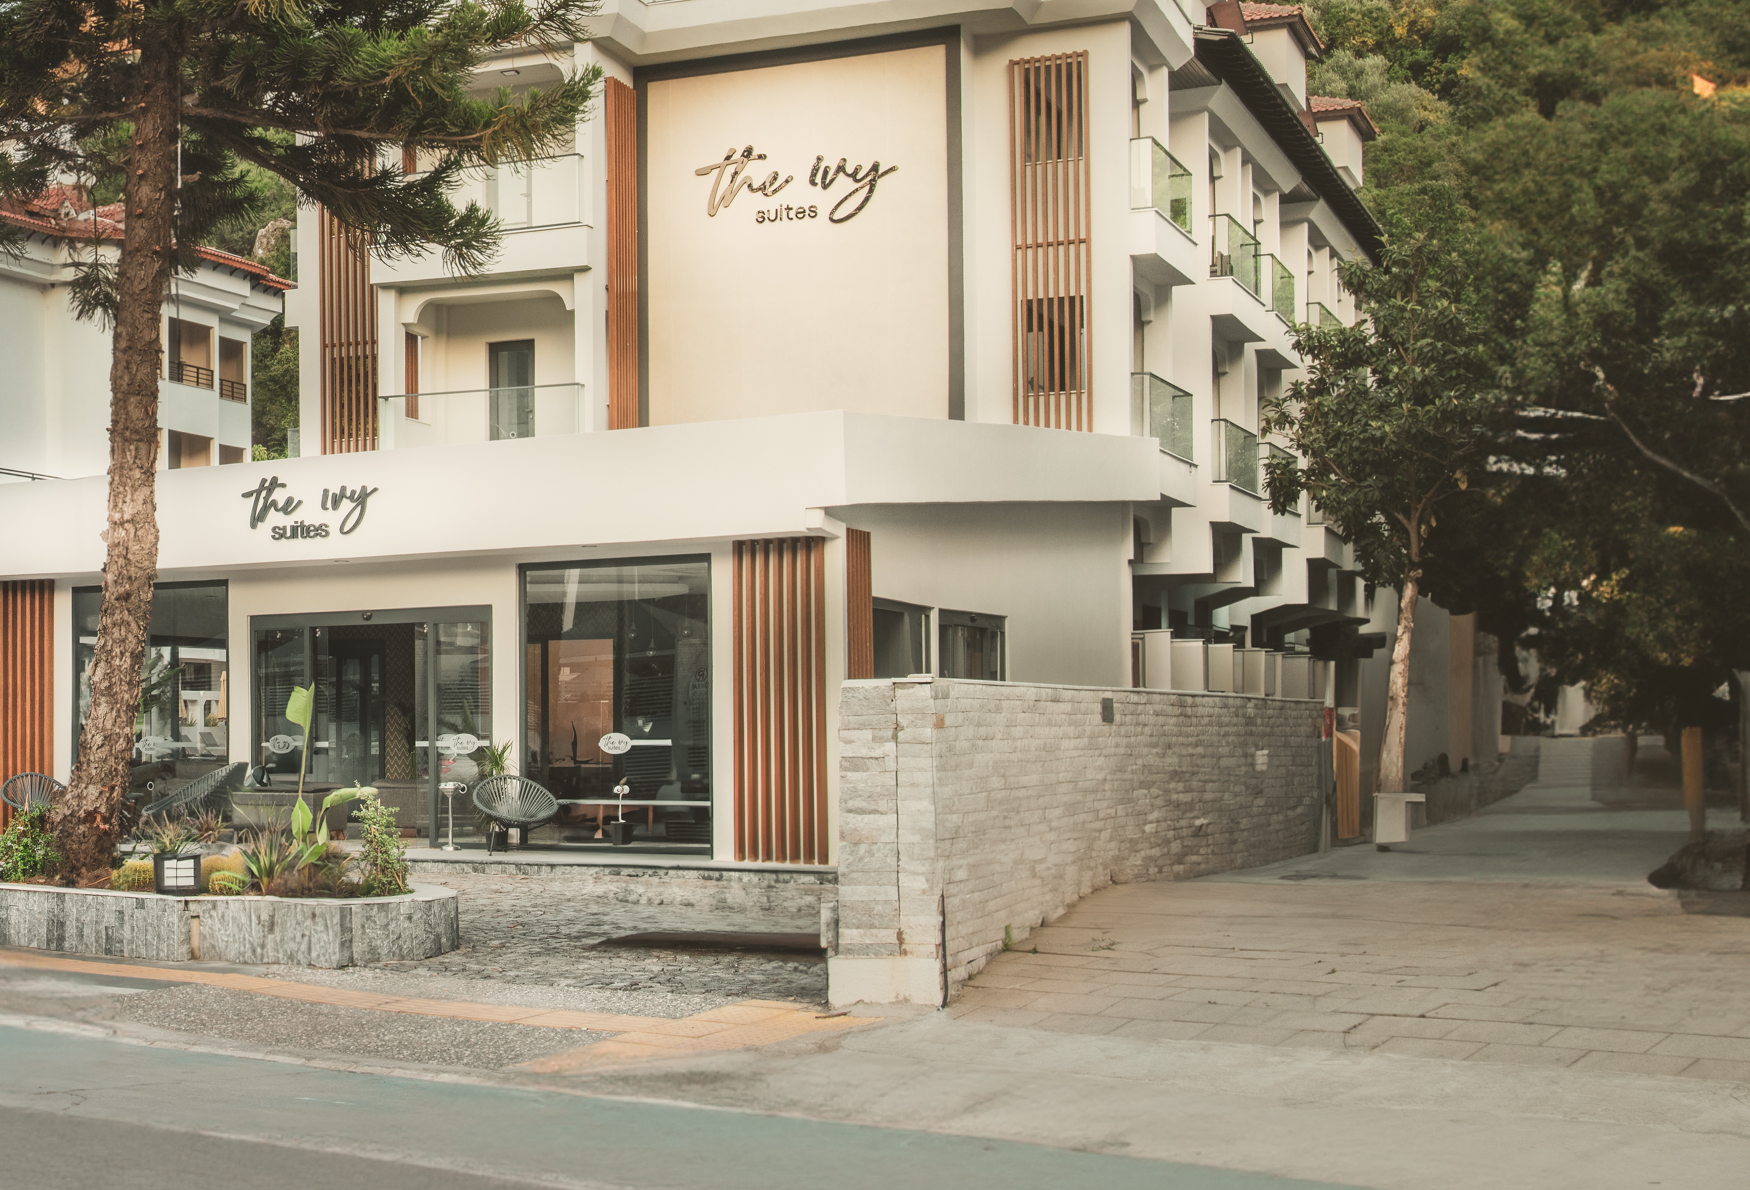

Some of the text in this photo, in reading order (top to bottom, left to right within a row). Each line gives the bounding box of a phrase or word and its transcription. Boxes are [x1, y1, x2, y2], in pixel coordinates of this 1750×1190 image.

[694, 144, 899, 224] the ivy
[755, 204, 818, 224] suites
[241, 476, 379, 535] the ivy
[270, 520, 330, 540] suites
